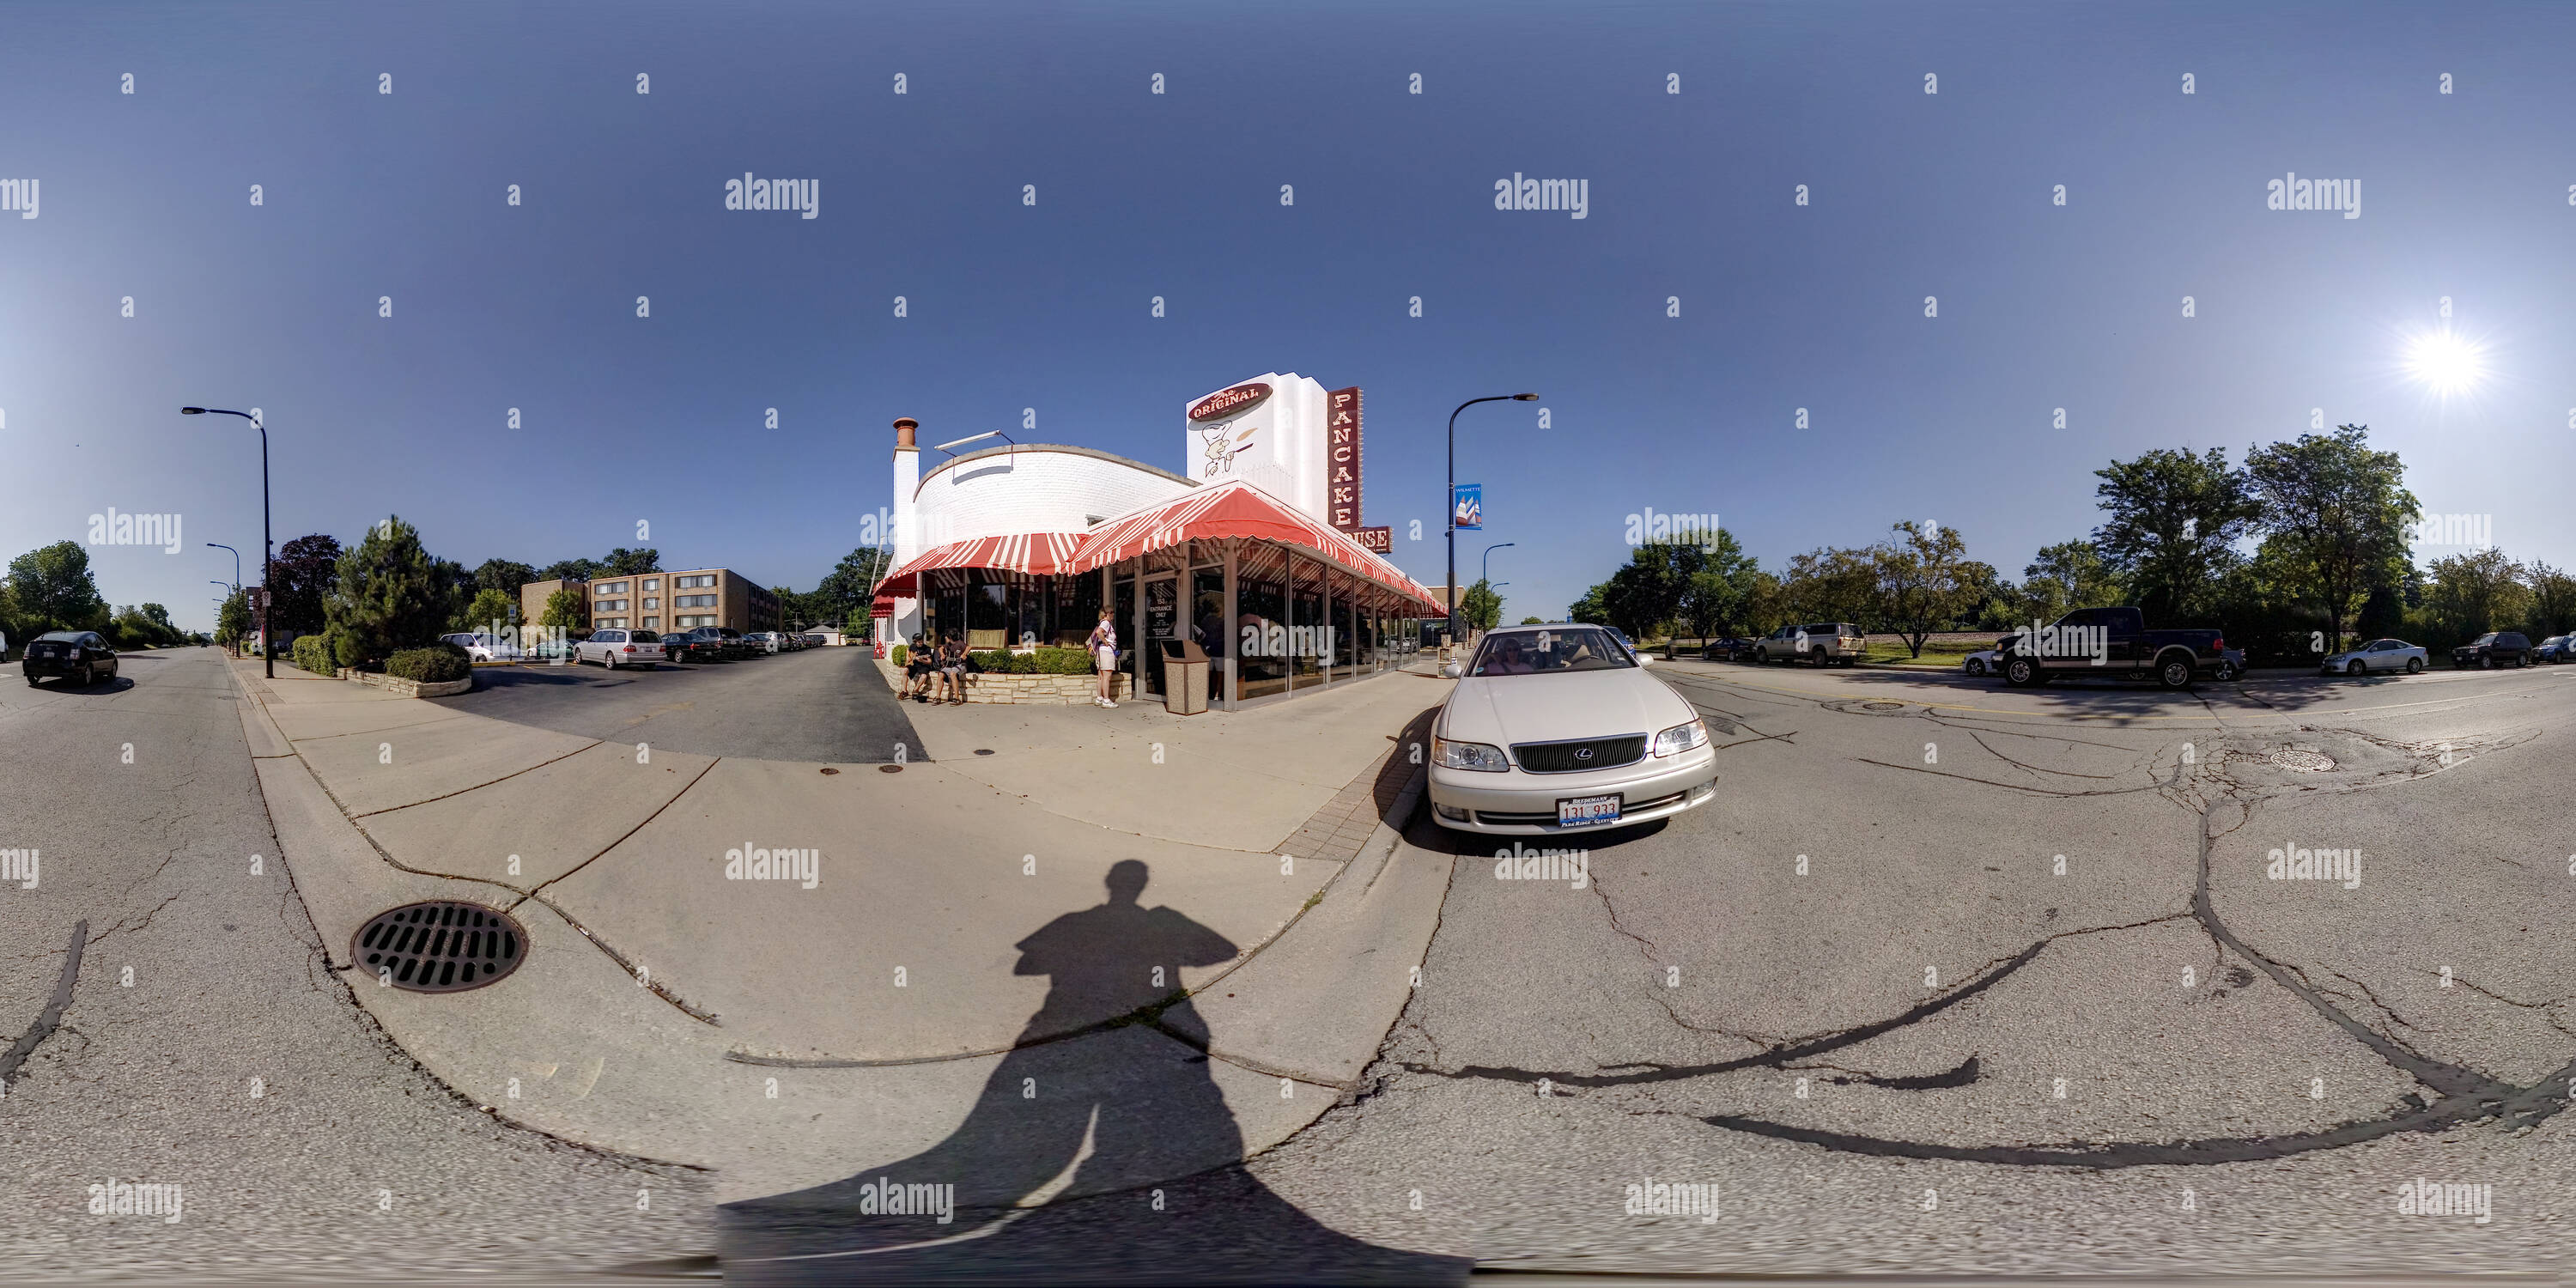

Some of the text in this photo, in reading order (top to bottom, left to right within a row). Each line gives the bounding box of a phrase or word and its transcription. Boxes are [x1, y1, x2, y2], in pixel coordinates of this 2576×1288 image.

[1194, 389, 1259, 418] ORIGINAL
[1210, 389, 1237, 403] The
[1333, 393, 1353, 526] PANCAKE
[1345, 530, 1387, 548] USE
[1564, 803, 1615, 820] 131 933
